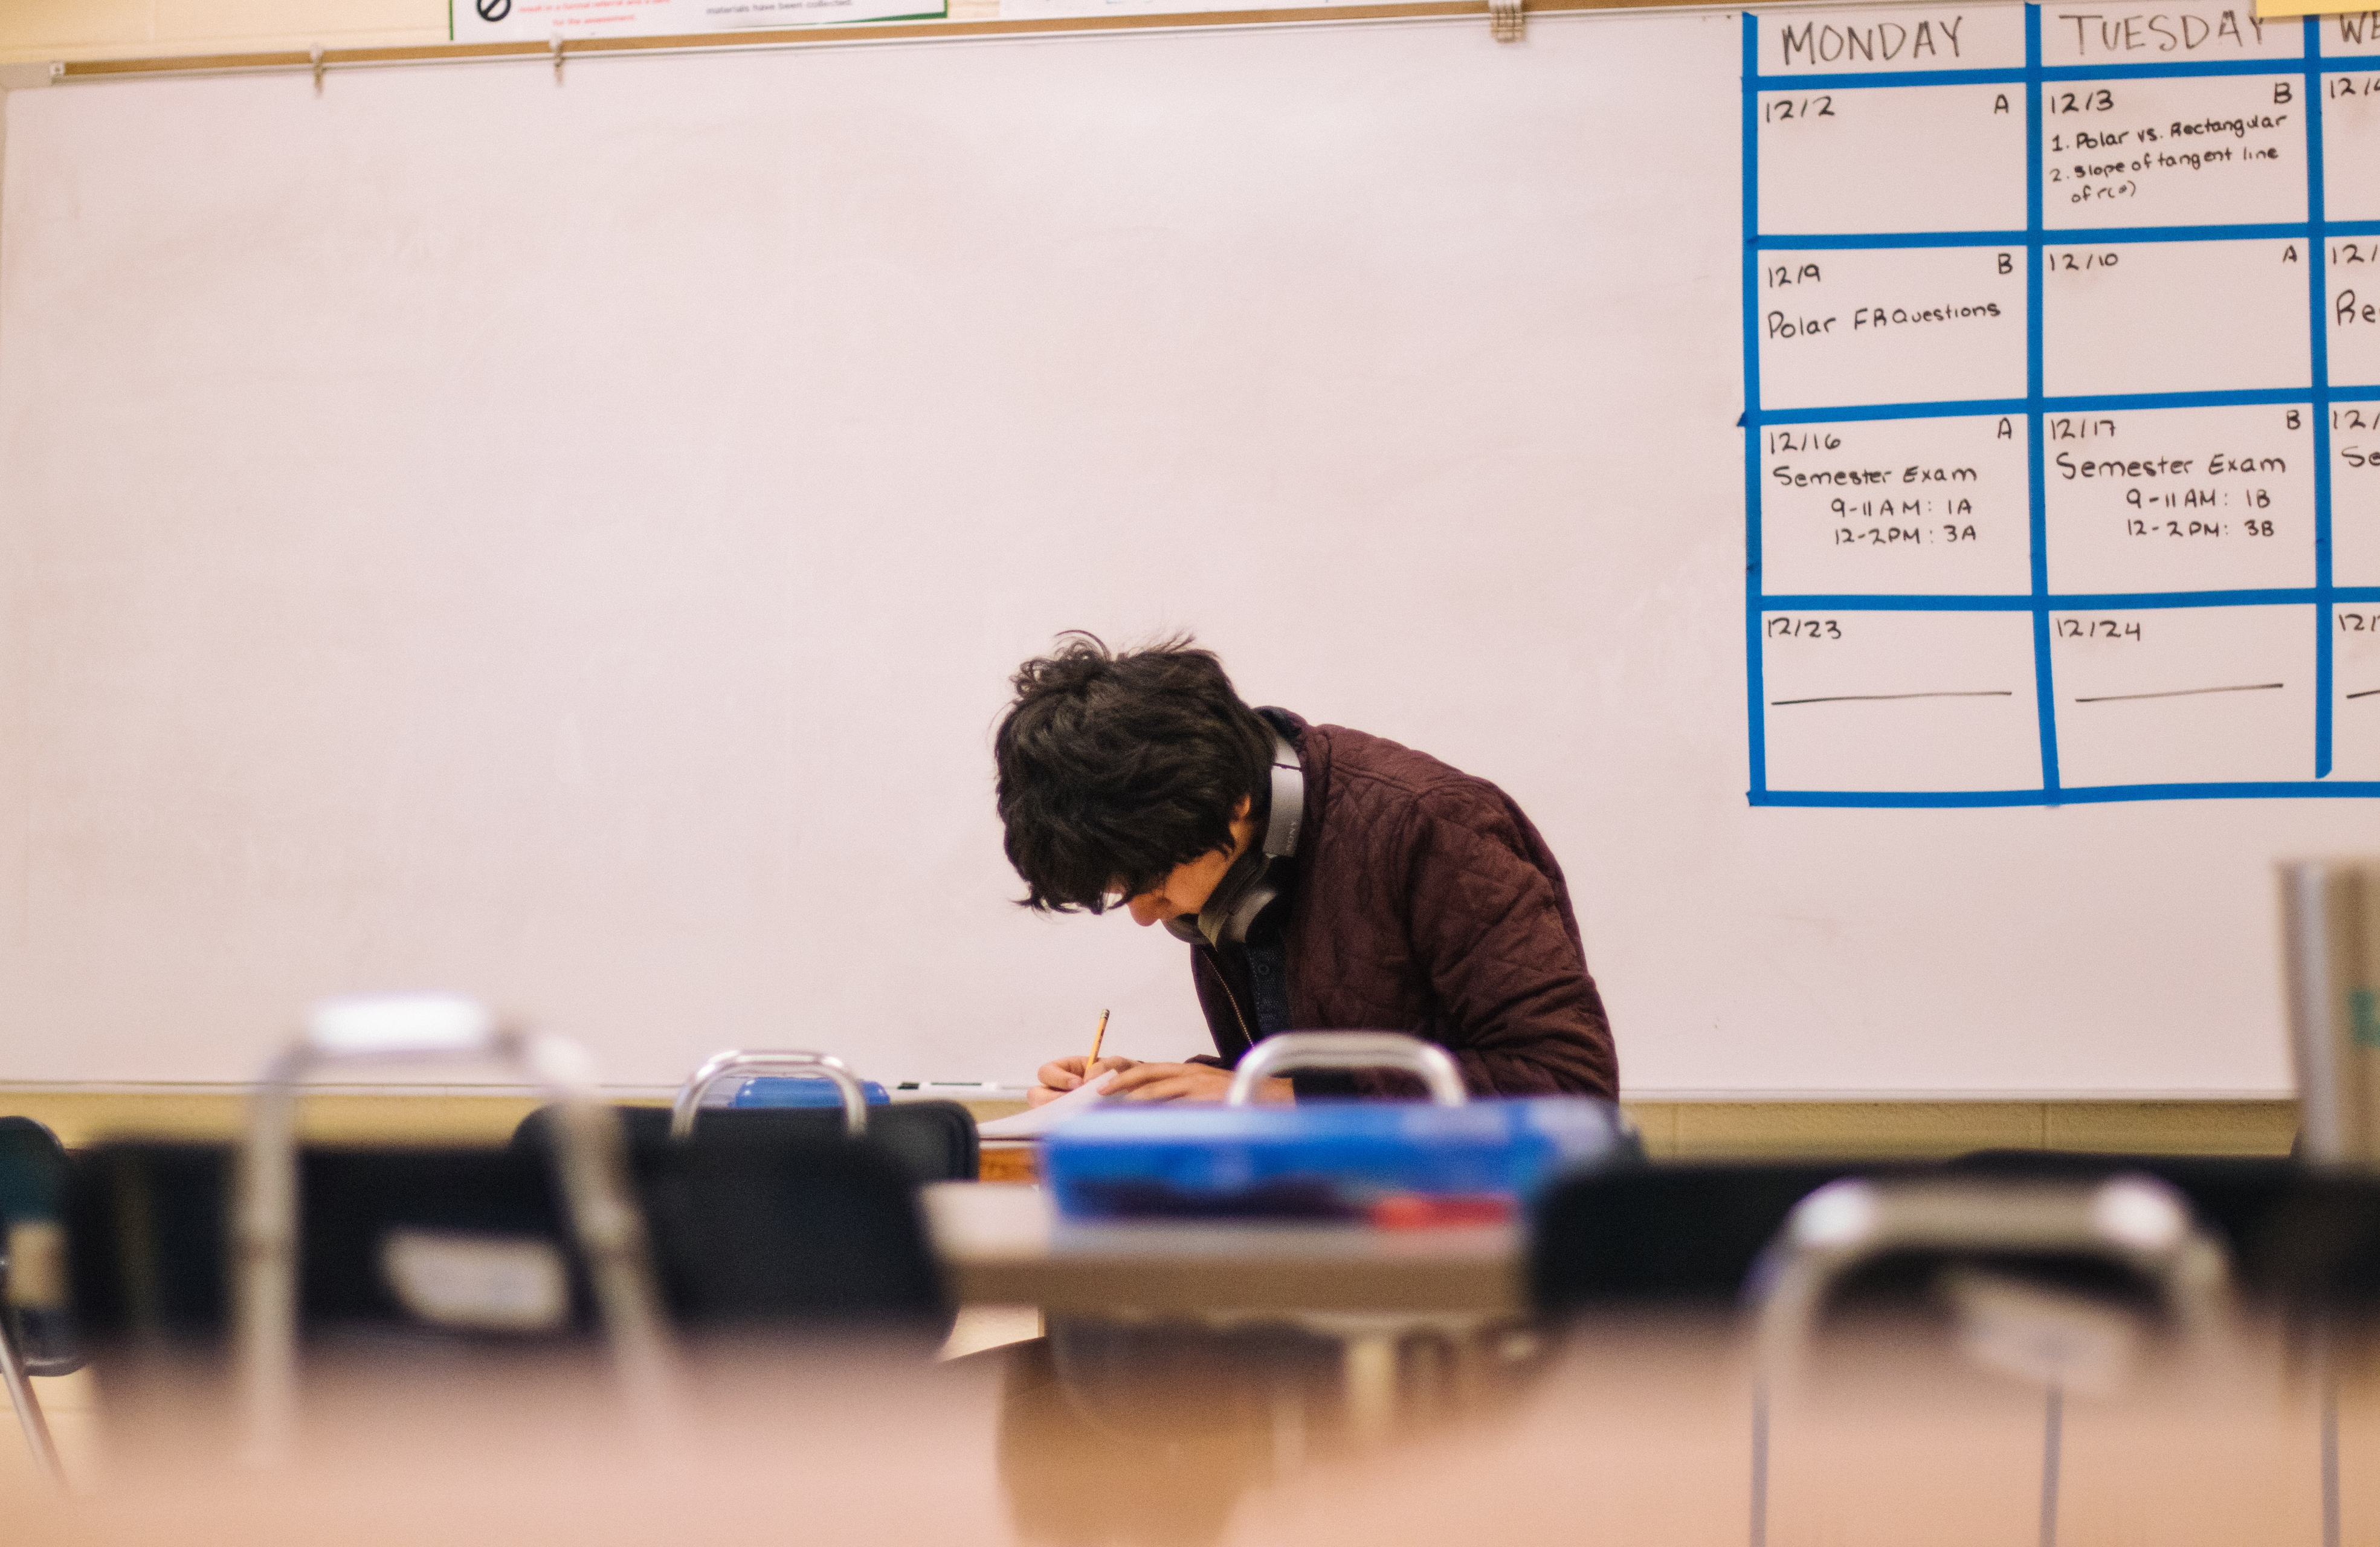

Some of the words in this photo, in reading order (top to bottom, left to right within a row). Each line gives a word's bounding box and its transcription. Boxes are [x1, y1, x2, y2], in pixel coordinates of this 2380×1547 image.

[1782, 16, 1962, 65] MONDAY
[2058, 10, 2263, 54] TUESDAY
[1994, 94, 2009, 114] A
[2051, 89, 2114, 114] 12/3
[2274, 82, 2292, 105] B
[1766, 95, 1835, 123] 12/2
[2052, 134, 2069, 152] 1.
[2076, 131, 2129, 149] Polar
[2137, 128, 2162, 143] vs.
[2170, 115, 2287, 138] Rectangular
[2131, 152, 2152, 172] of
[2157, 147, 2232, 170] tangent
[2243, 147, 2278, 160] line
[2071, 184, 2091, 203] of
[1998, 253, 2013, 275] B
[2049, 253, 2118, 271] 12/10
[2283, 245, 2297, 262] A
[1769, 263, 1820, 288] 12/9
[1767, 311, 1836, 338] Polar
[1998, 416, 2013, 439] A
[2051, 418, 2115, 440] 12/17
[2286, 409, 2301, 430] B
[1771, 431, 1841, 454] 12/16
[2056, 451, 2193, 480] Semester
[2208, 453, 2286, 476] Exam
[2341, 446, 2380, 468] Se
[1773, 465, 1892, 488] Semester
[1903, 466, 1977, 483] Exam
[1948, 499, 1972, 514] 1A
[2246, 489, 2271, 508] 1B
[1943, 525, 1976, 542] 3A
[2244, 519, 2274, 537] 3B
[1768, 617, 1842, 639] 12/23
[2057, 619, 2141, 641] 12/24
[2338, 613, 2380, 632] 12/
